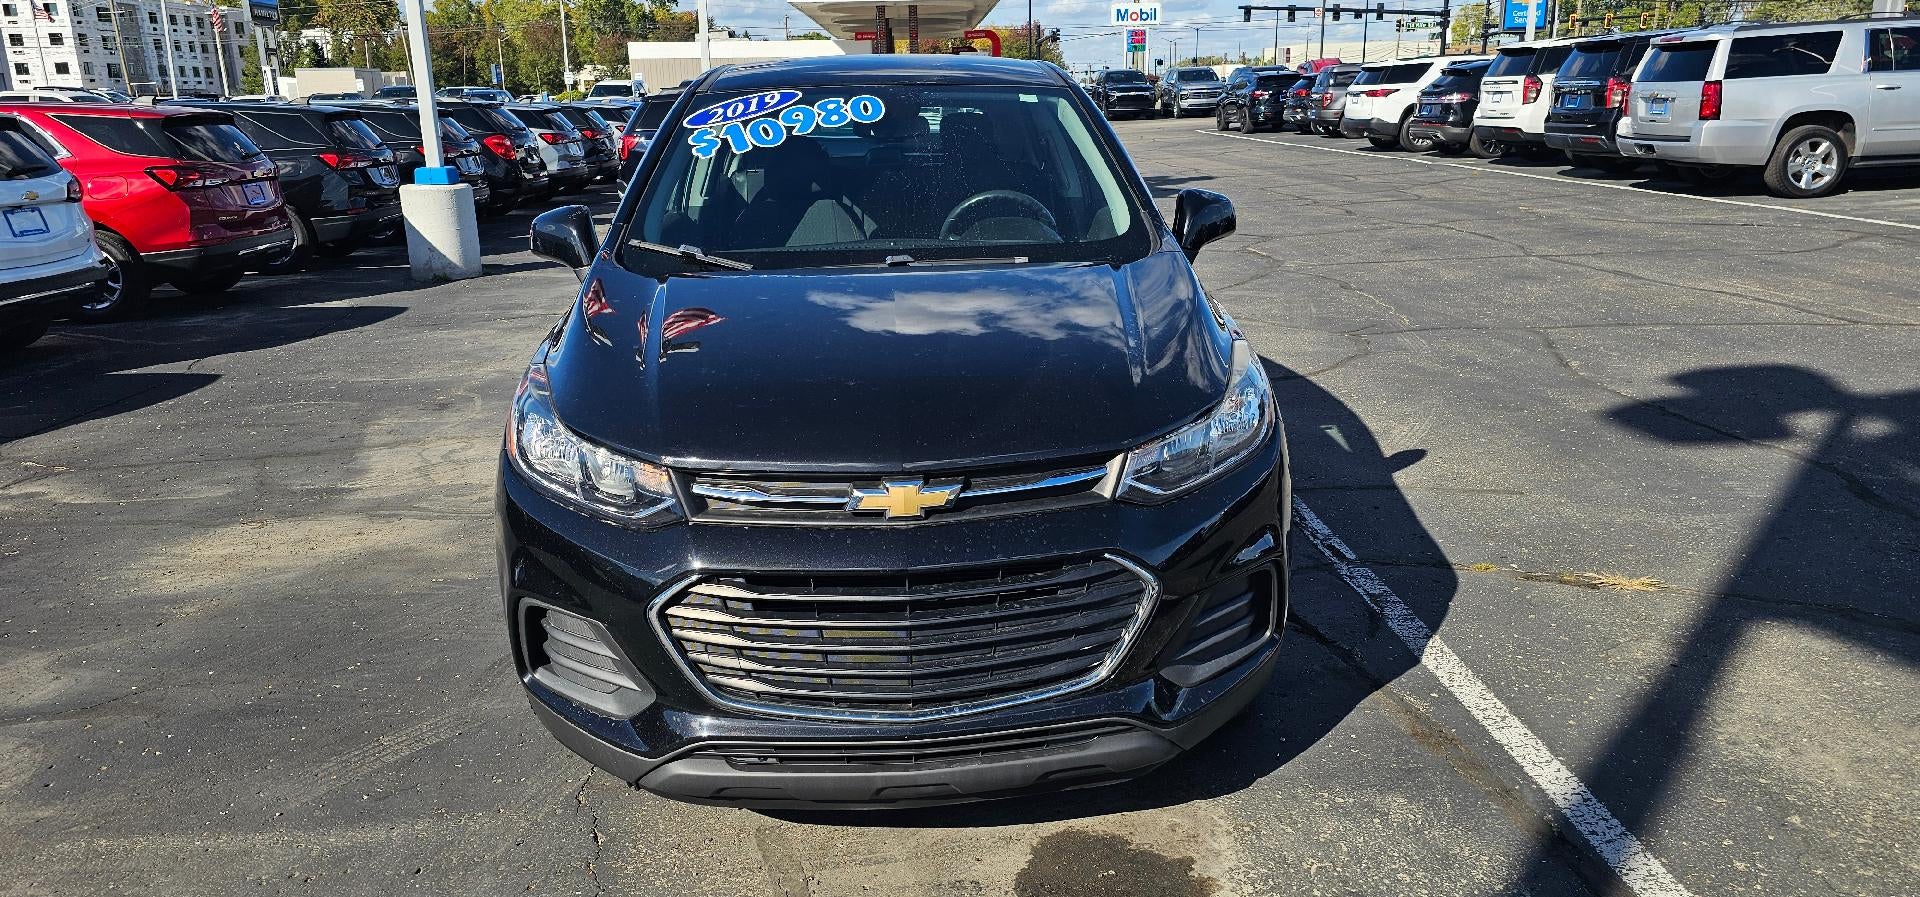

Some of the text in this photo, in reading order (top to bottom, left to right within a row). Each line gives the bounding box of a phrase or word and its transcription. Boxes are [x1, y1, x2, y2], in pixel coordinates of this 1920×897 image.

[1116, 8, 1157, 21] Mobil
[708, 94, 781, 122] 2019
[688, 95, 885, 159] $10980
